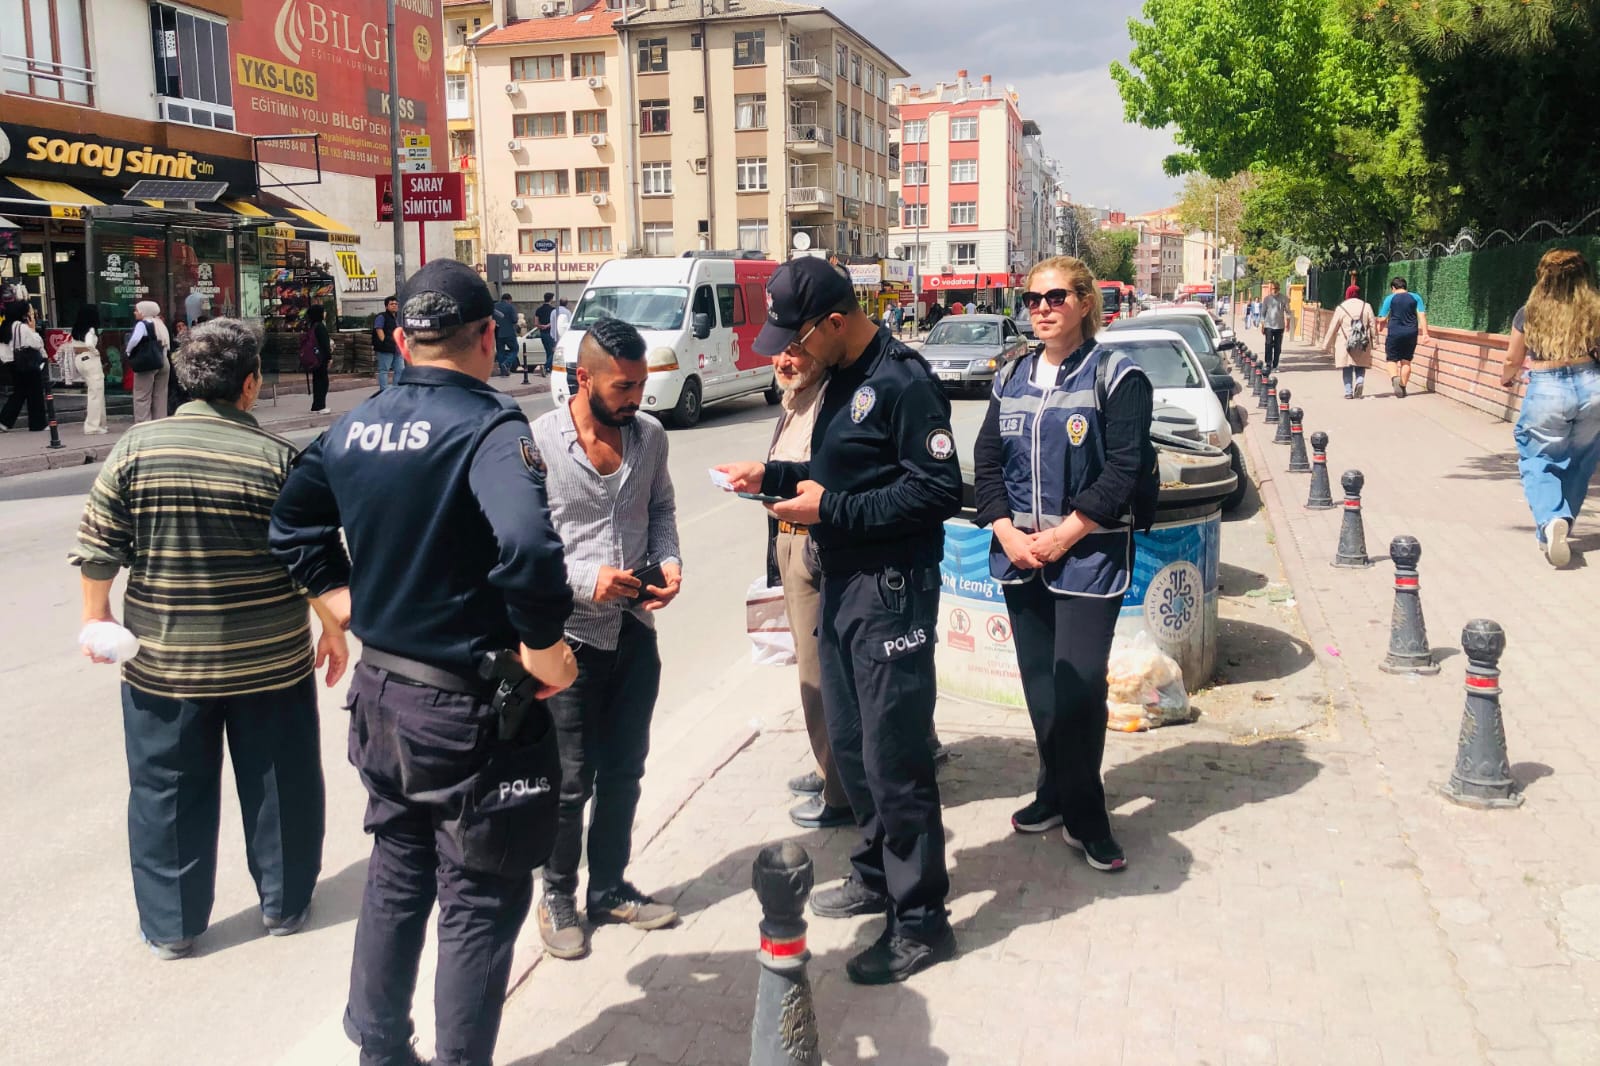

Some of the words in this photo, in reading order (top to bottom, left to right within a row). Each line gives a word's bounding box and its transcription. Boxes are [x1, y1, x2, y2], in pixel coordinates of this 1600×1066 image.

[417, 32, 428, 45] 25
[241, 57, 315, 98] YKS-LGS
[251, 95, 299, 119] EĞİTİMİN
[302, 107, 329, 125] YOLU
[381, 92, 415, 120] KSS
[26, 135, 124, 177] saray
[415, 163, 426, 171] 24
[410, 177, 444, 193] SARAY
[404, 196, 452, 218] SİMİTÇİM
[344, 420, 432, 452] POLİS
[959, 576, 994, 598] temiz
[883, 627, 928, 657] POLİS
